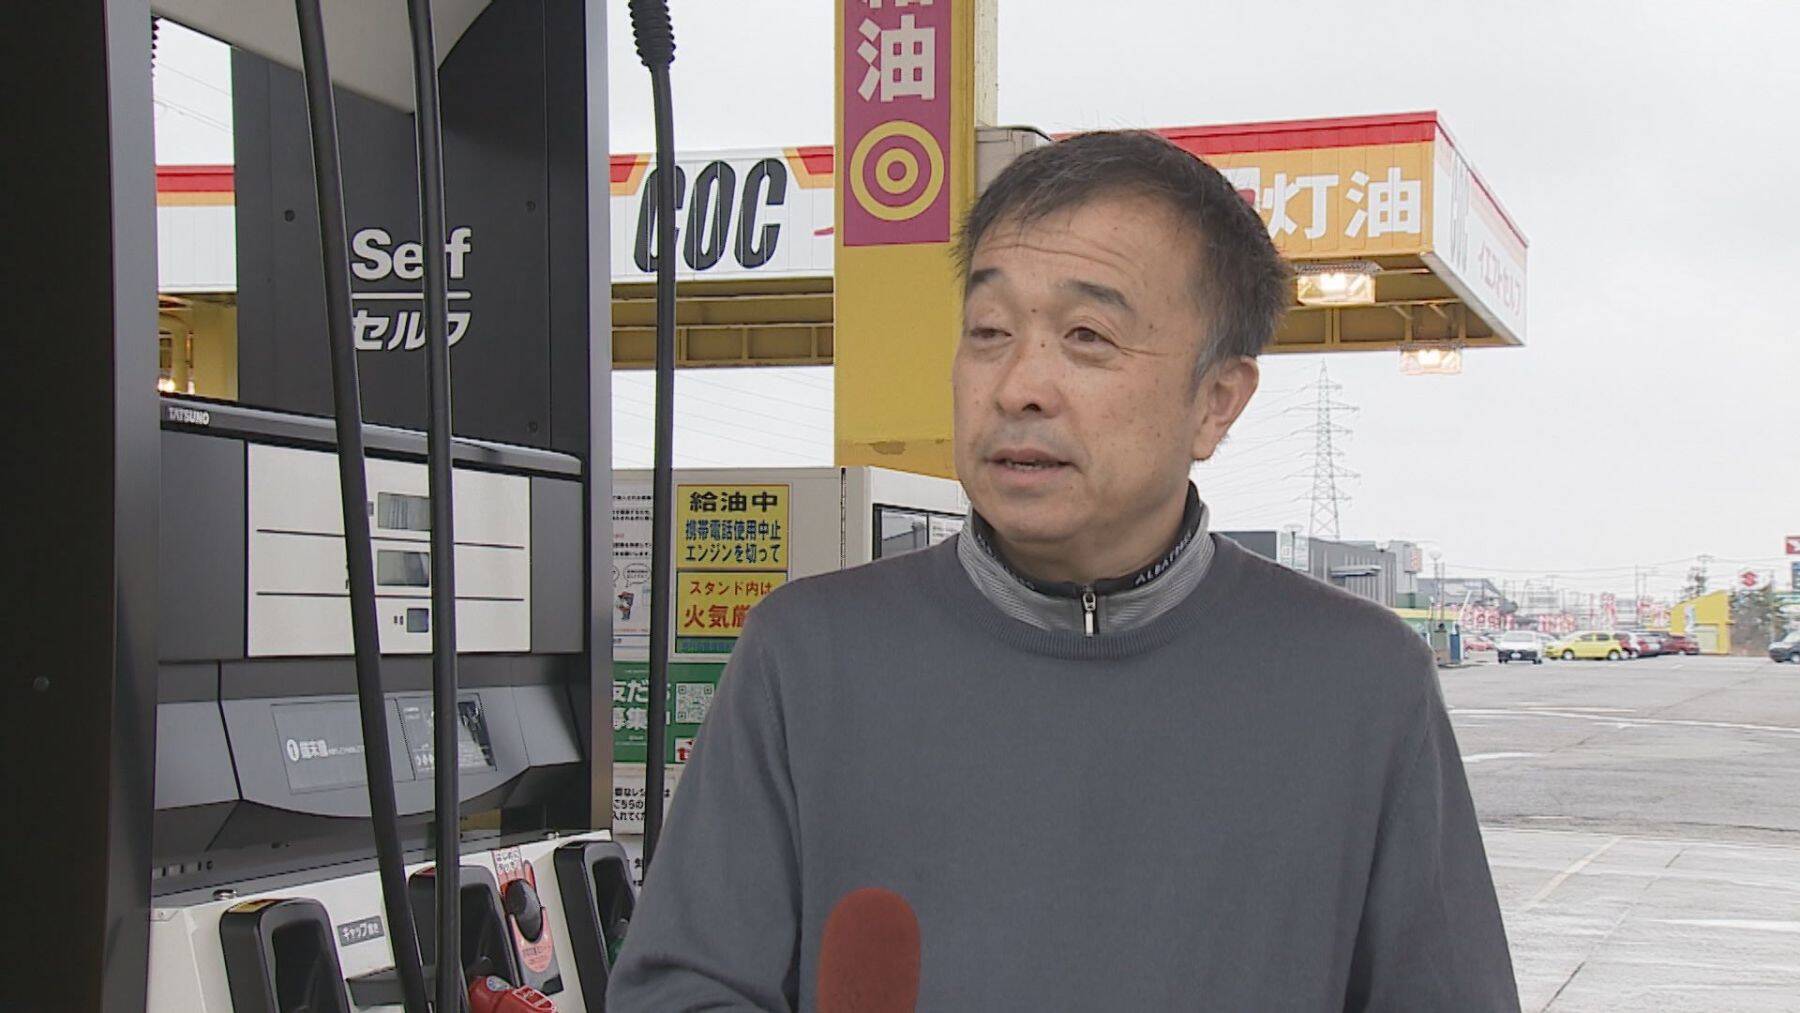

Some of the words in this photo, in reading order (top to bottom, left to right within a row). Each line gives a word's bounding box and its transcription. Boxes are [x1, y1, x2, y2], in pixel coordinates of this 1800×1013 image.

[1262, 166, 1422, 240] 灯油
[633, 158, 788, 273] COC
[352, 227, 471, 280] Sef
[168, 406, 210, 425] TATSUNO
[689, 491, 778, 513] 給油中
[685, 519, 781, 541] 携帯電話使用中止
[685, 543, 781, 564] エンジンを切って
[690, 580, 773, 597] スタンド内は
